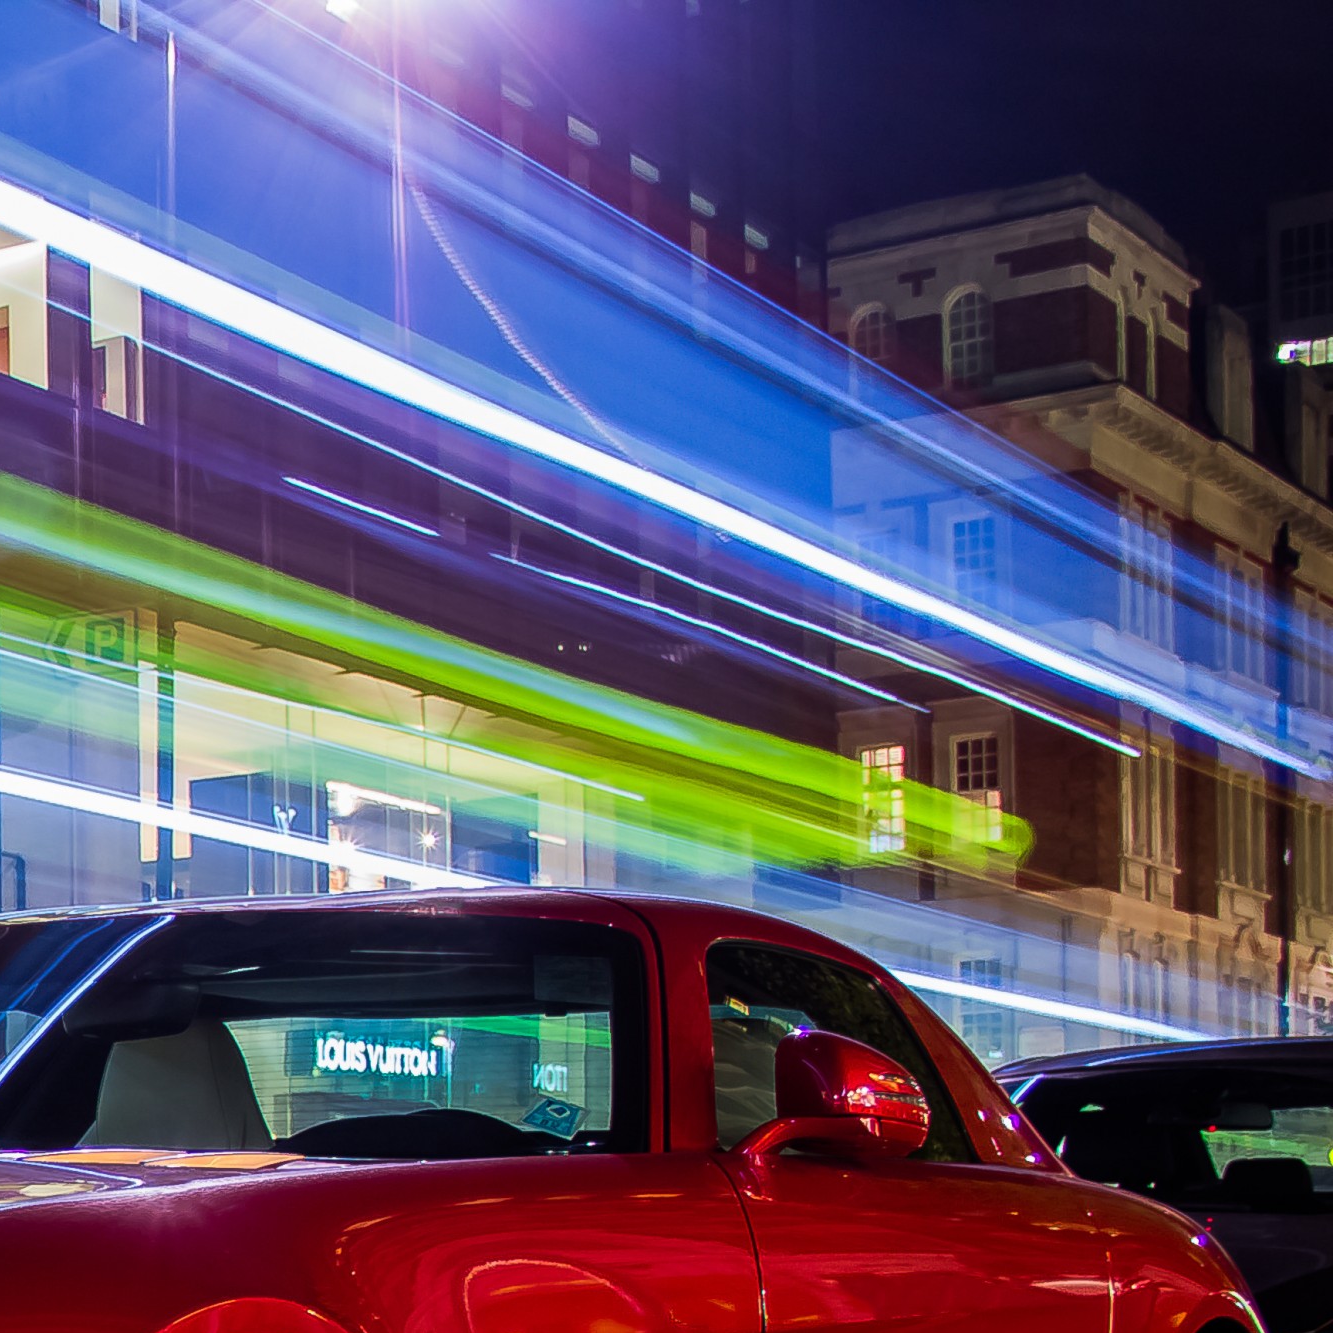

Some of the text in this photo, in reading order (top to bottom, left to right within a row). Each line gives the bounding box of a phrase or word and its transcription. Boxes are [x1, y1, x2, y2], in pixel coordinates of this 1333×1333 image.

[94, 624, 118, 660] P
[316, 1038, 437, 1077] LOUIS VUITTON
